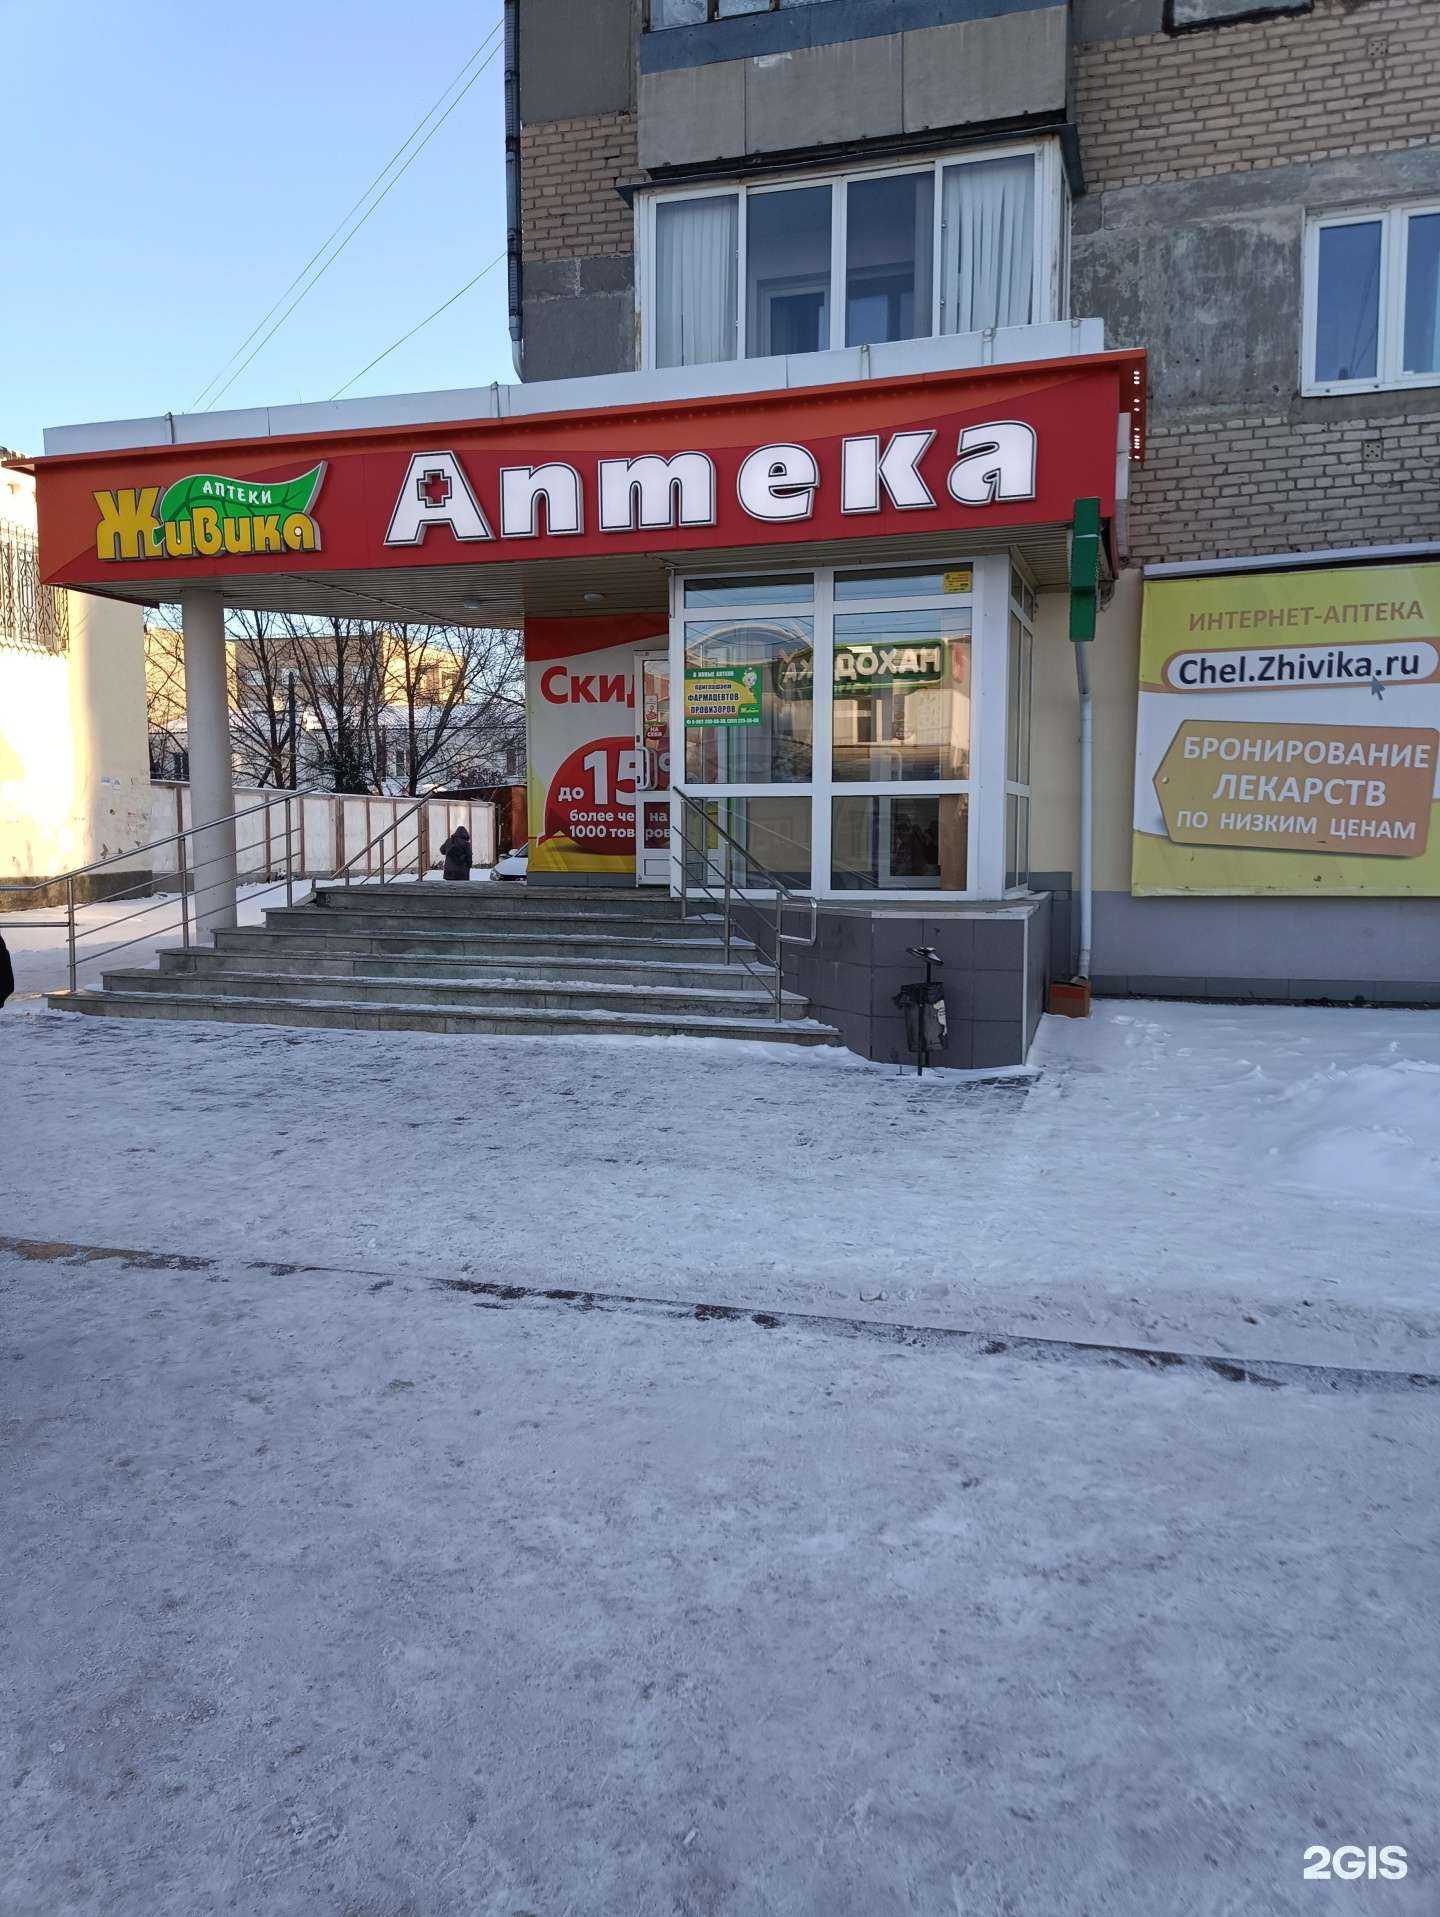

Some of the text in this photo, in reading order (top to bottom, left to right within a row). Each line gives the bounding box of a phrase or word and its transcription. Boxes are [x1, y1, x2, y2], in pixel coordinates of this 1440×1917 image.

[202, 480, 273, 506] АПТЕКИ
[383, 420, 1039, 547] Аптека
[93, 486, 322, 562] Живика
[1188, 599, 1425, 632] ИНТЕРНЕТ-АПТЕКА
[1178, 650, 1420, 686] Chel.Zhivika.ru
[688, 693, 739, 701] ФАРМАЦЕВТОВ
[690, 705, 736, 714] ПРОВИЗОРОВ
[1183, 736, 1432, 770] БРОНИРОВАНИЕ
[558, 786, 585, 803] до
[1211, 773, 1388, 808] ЛЕКАРСТВ
[569, 808, 669, 822] более че на
[570, 825, 607, 838] 1000
[1177, 810, 1417, 843] ПО НИЗКИМ ЦЕНАМ
